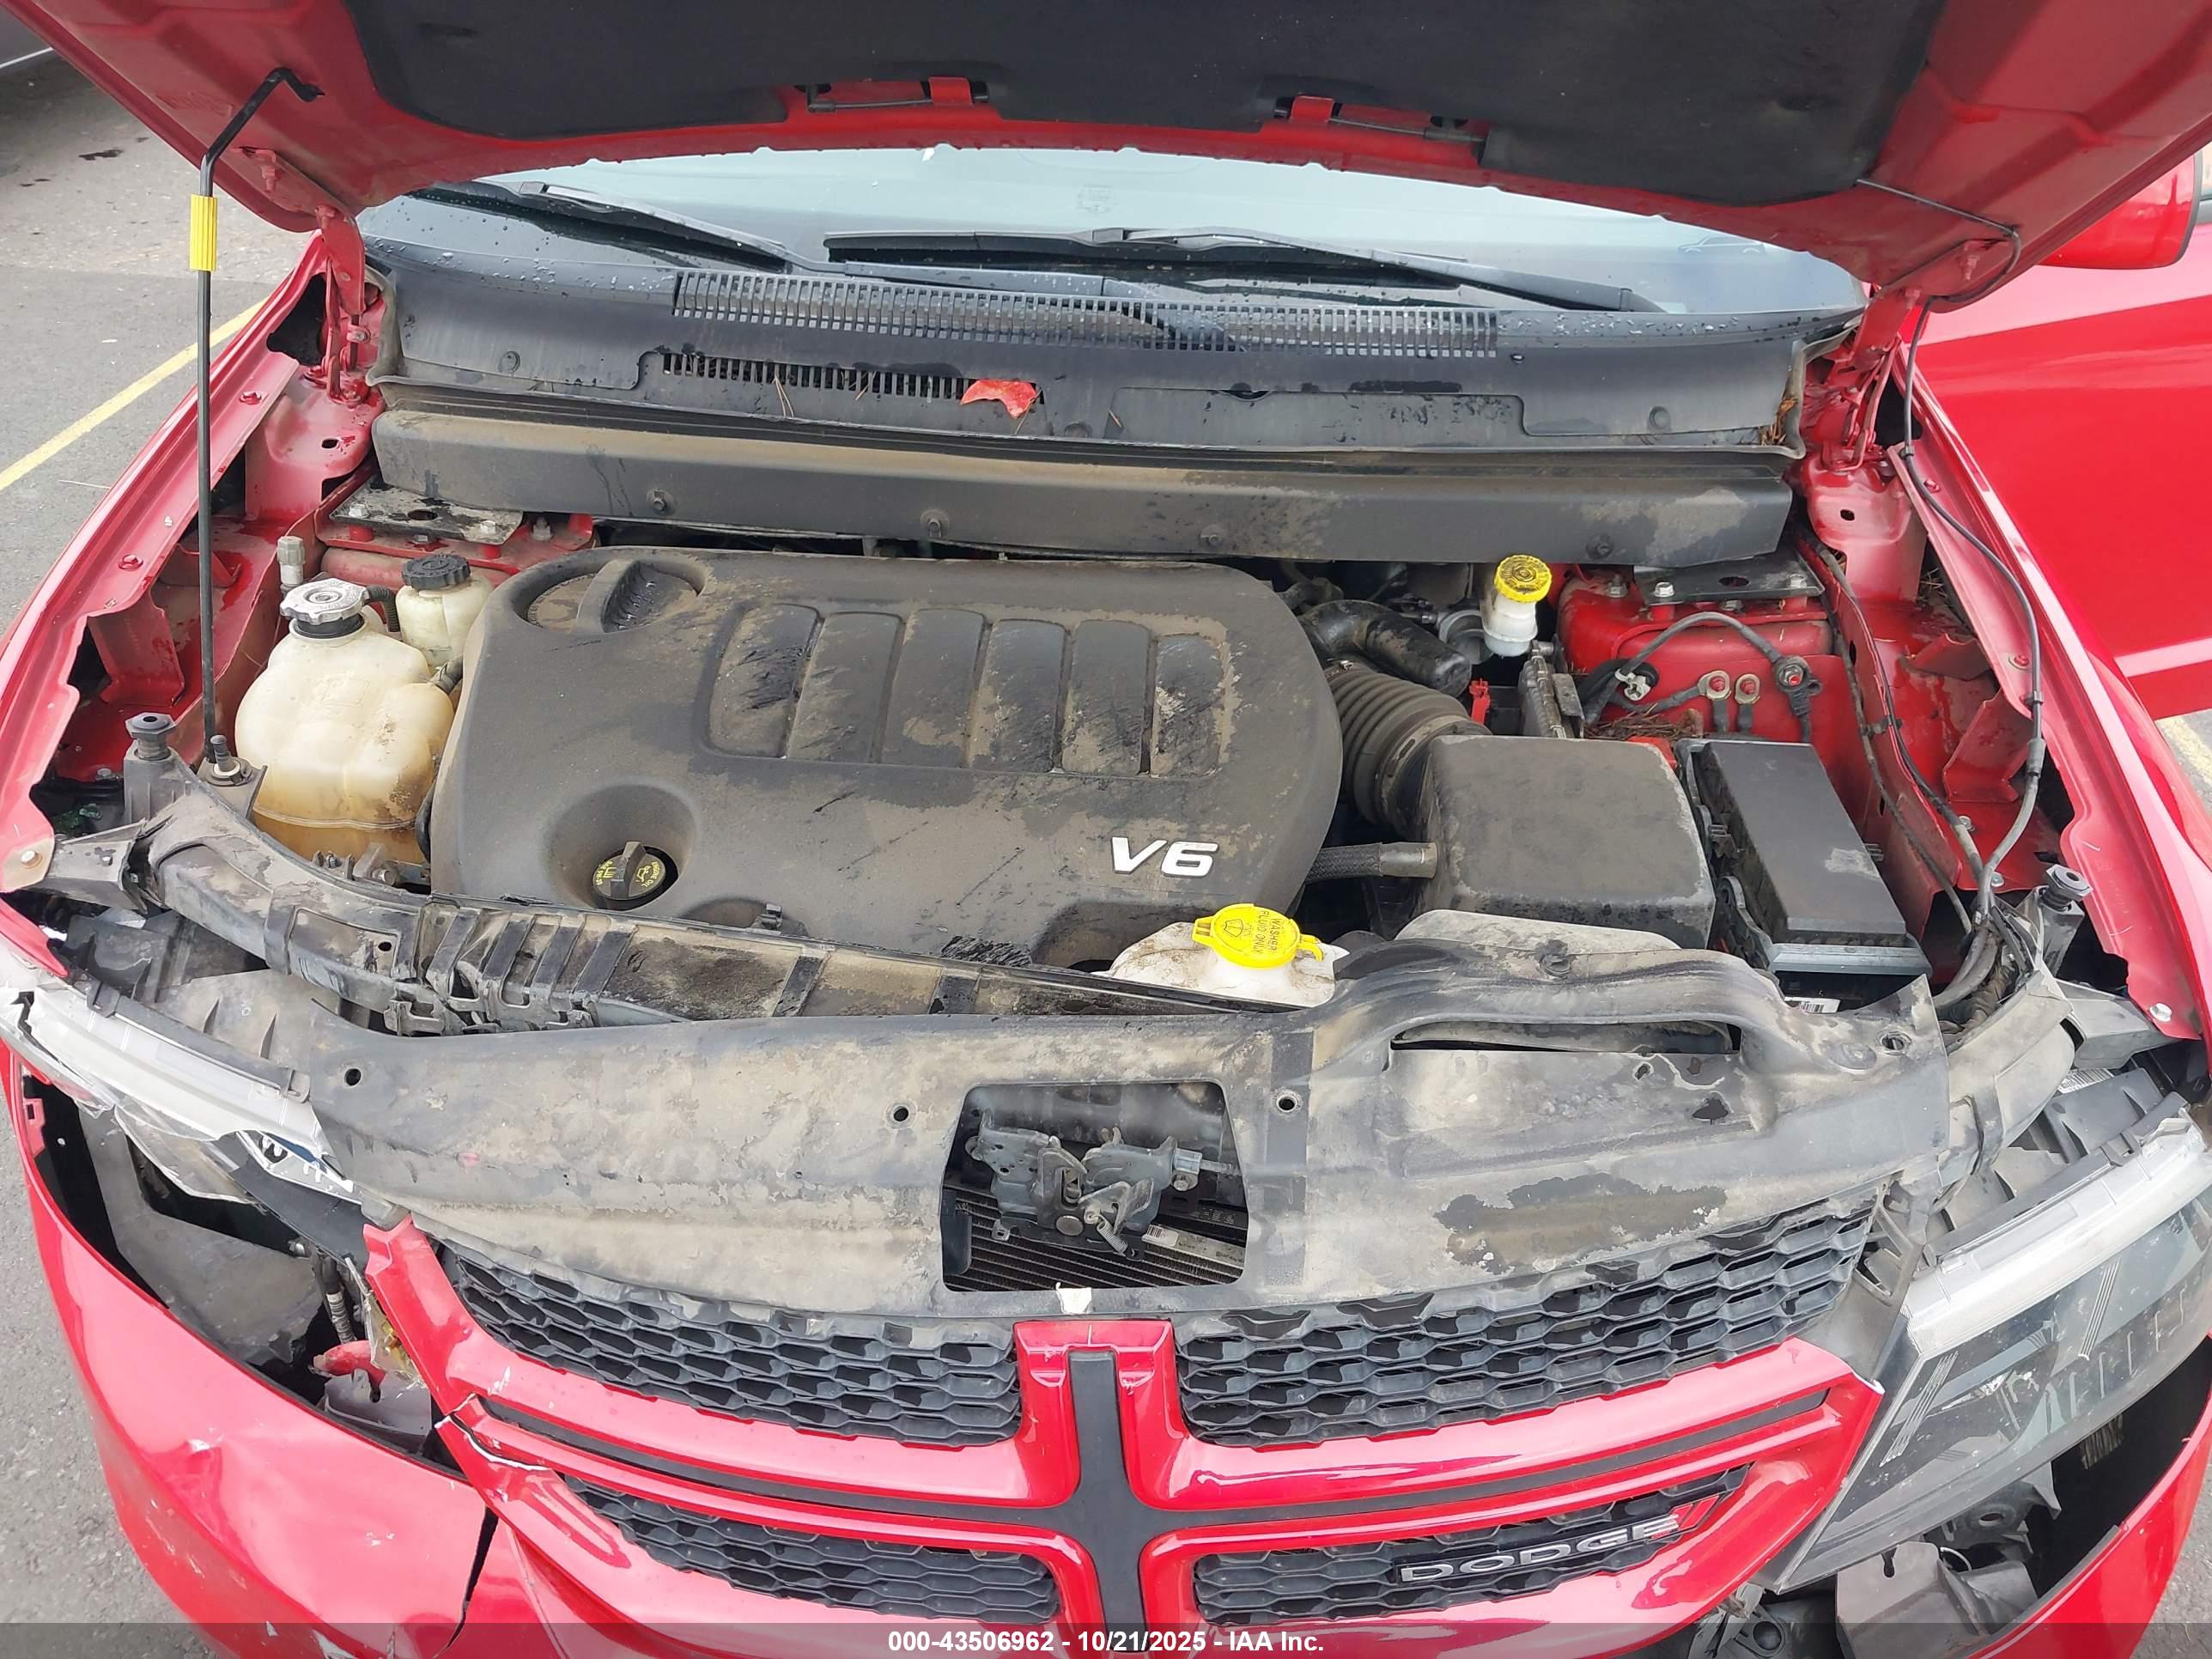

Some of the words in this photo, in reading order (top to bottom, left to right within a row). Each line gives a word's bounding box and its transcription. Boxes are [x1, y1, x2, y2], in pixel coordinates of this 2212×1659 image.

[1111, 836, 1218, 877] V6
[641, 879, 653, 888] OIL
[1256, 910, 1270, 935] FLUID
[1267, 918, 1283, 951] WASHER
[1253, 933, 1267, 955] ONLY
[1401, 1513, 1680, 1583] DODGE
